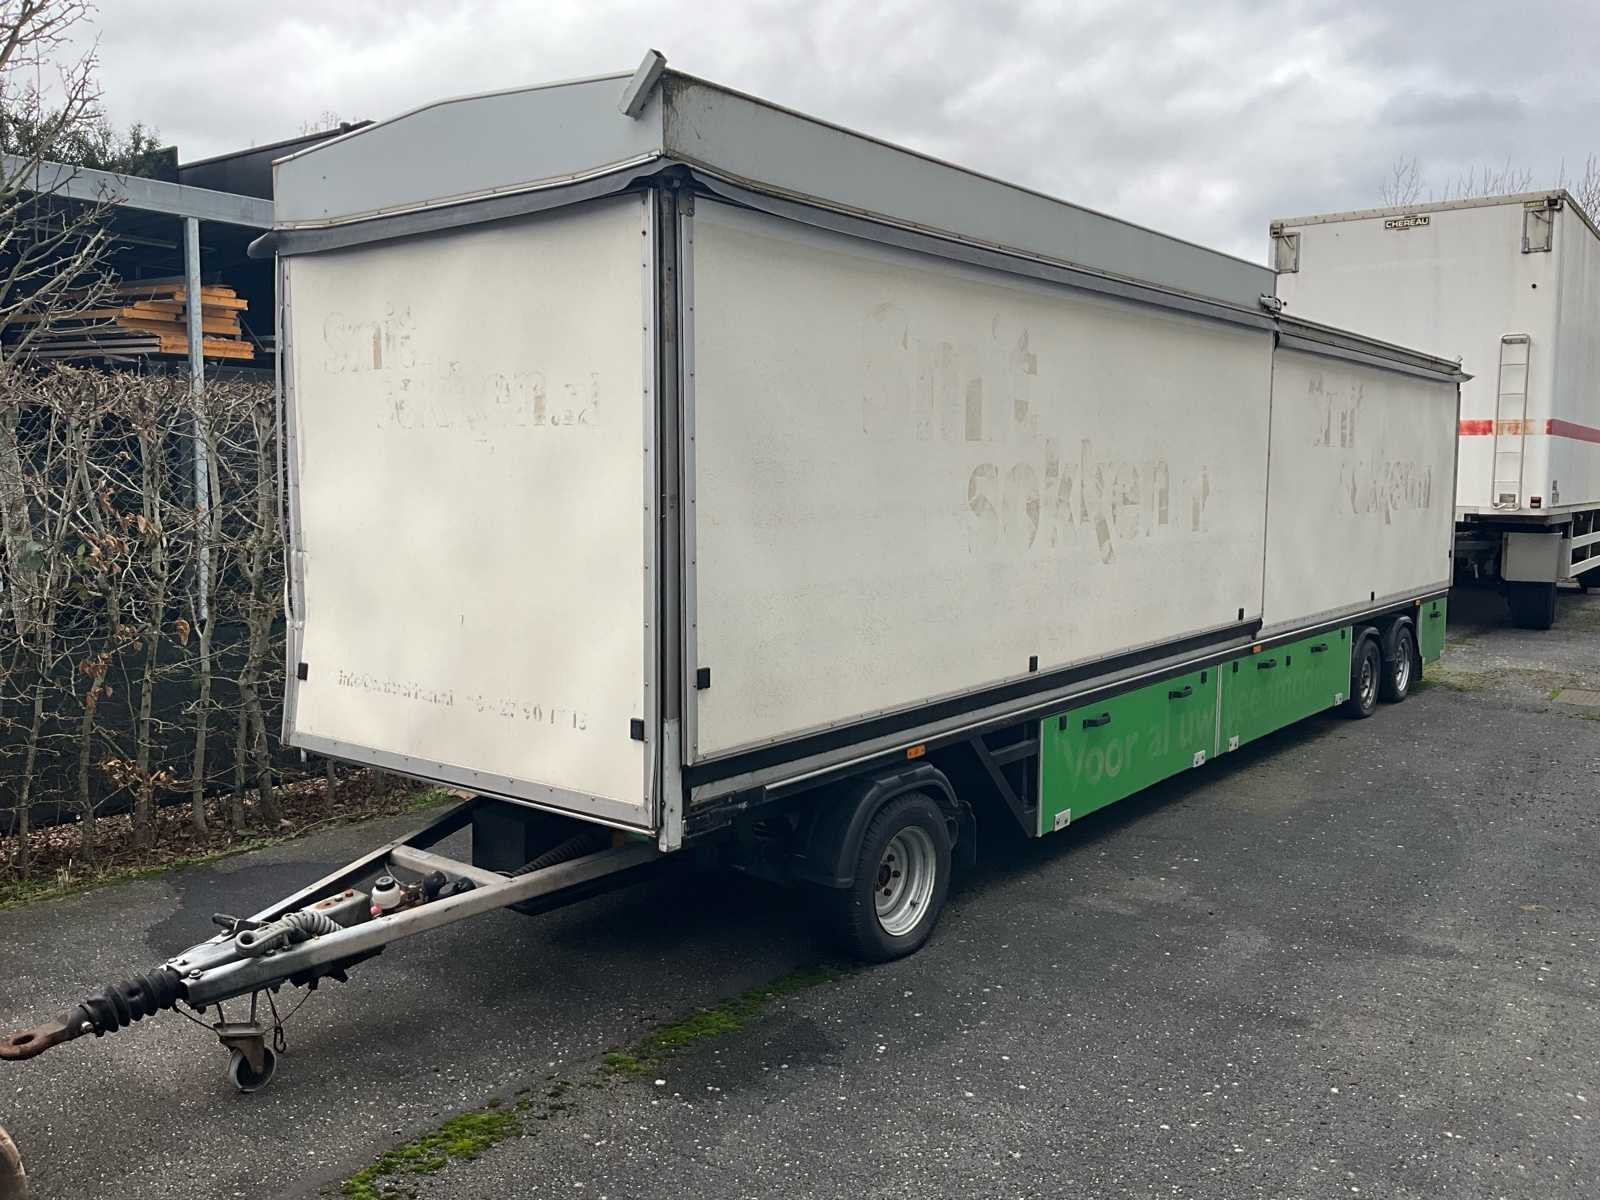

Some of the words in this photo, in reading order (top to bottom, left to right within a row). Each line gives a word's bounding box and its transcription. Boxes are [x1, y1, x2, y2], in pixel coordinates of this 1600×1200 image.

[1385, 217, 1429, 229] CHEREAU
[1056, 732, 1138, 791] Voor
[1150, 704, 1169, 757] al
